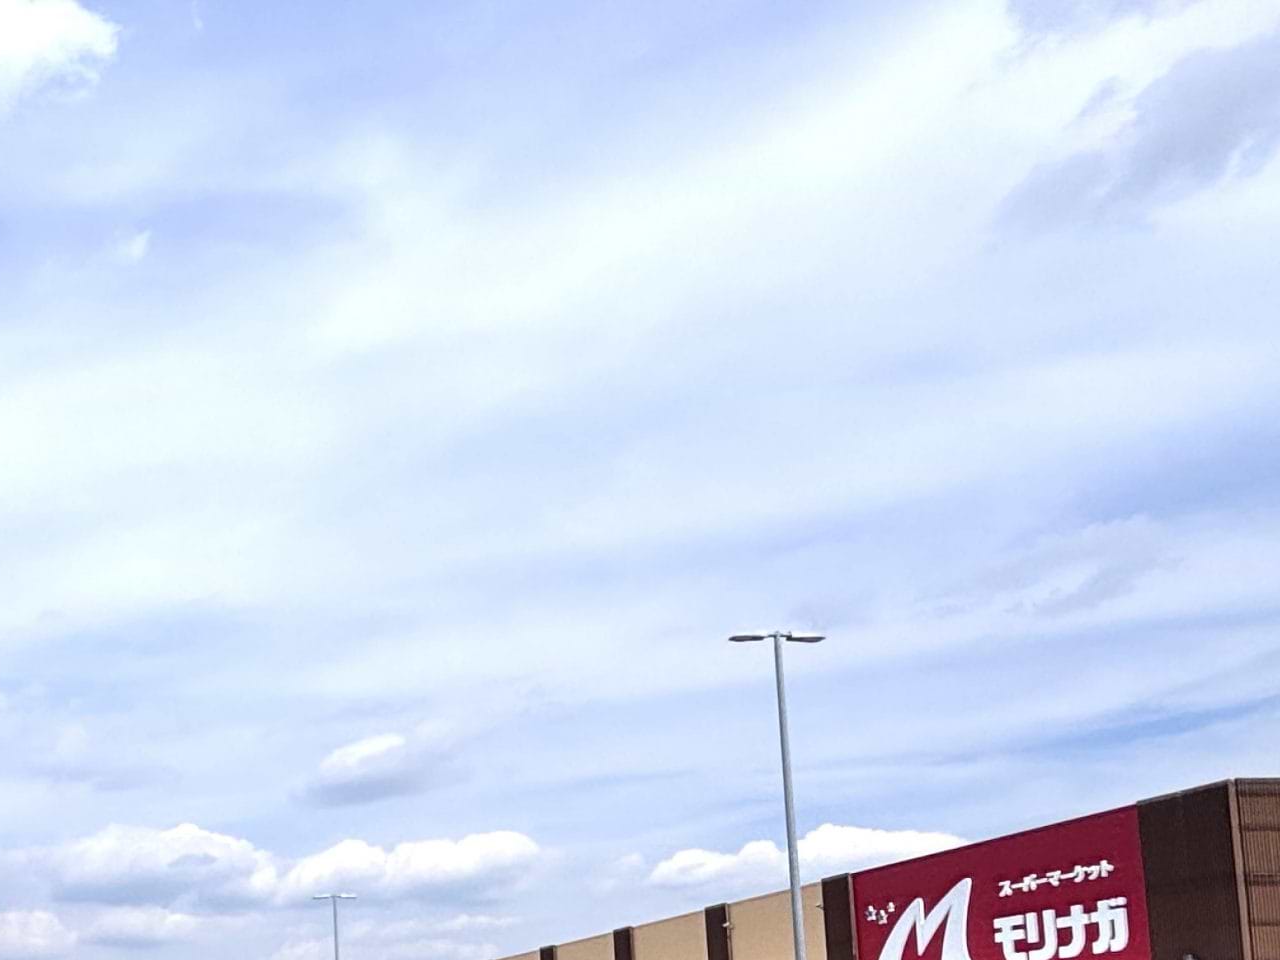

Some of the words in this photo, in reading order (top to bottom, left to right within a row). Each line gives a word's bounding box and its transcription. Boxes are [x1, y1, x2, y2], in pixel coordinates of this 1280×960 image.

[998, 859, 1115, 898] スーパーマーケット
